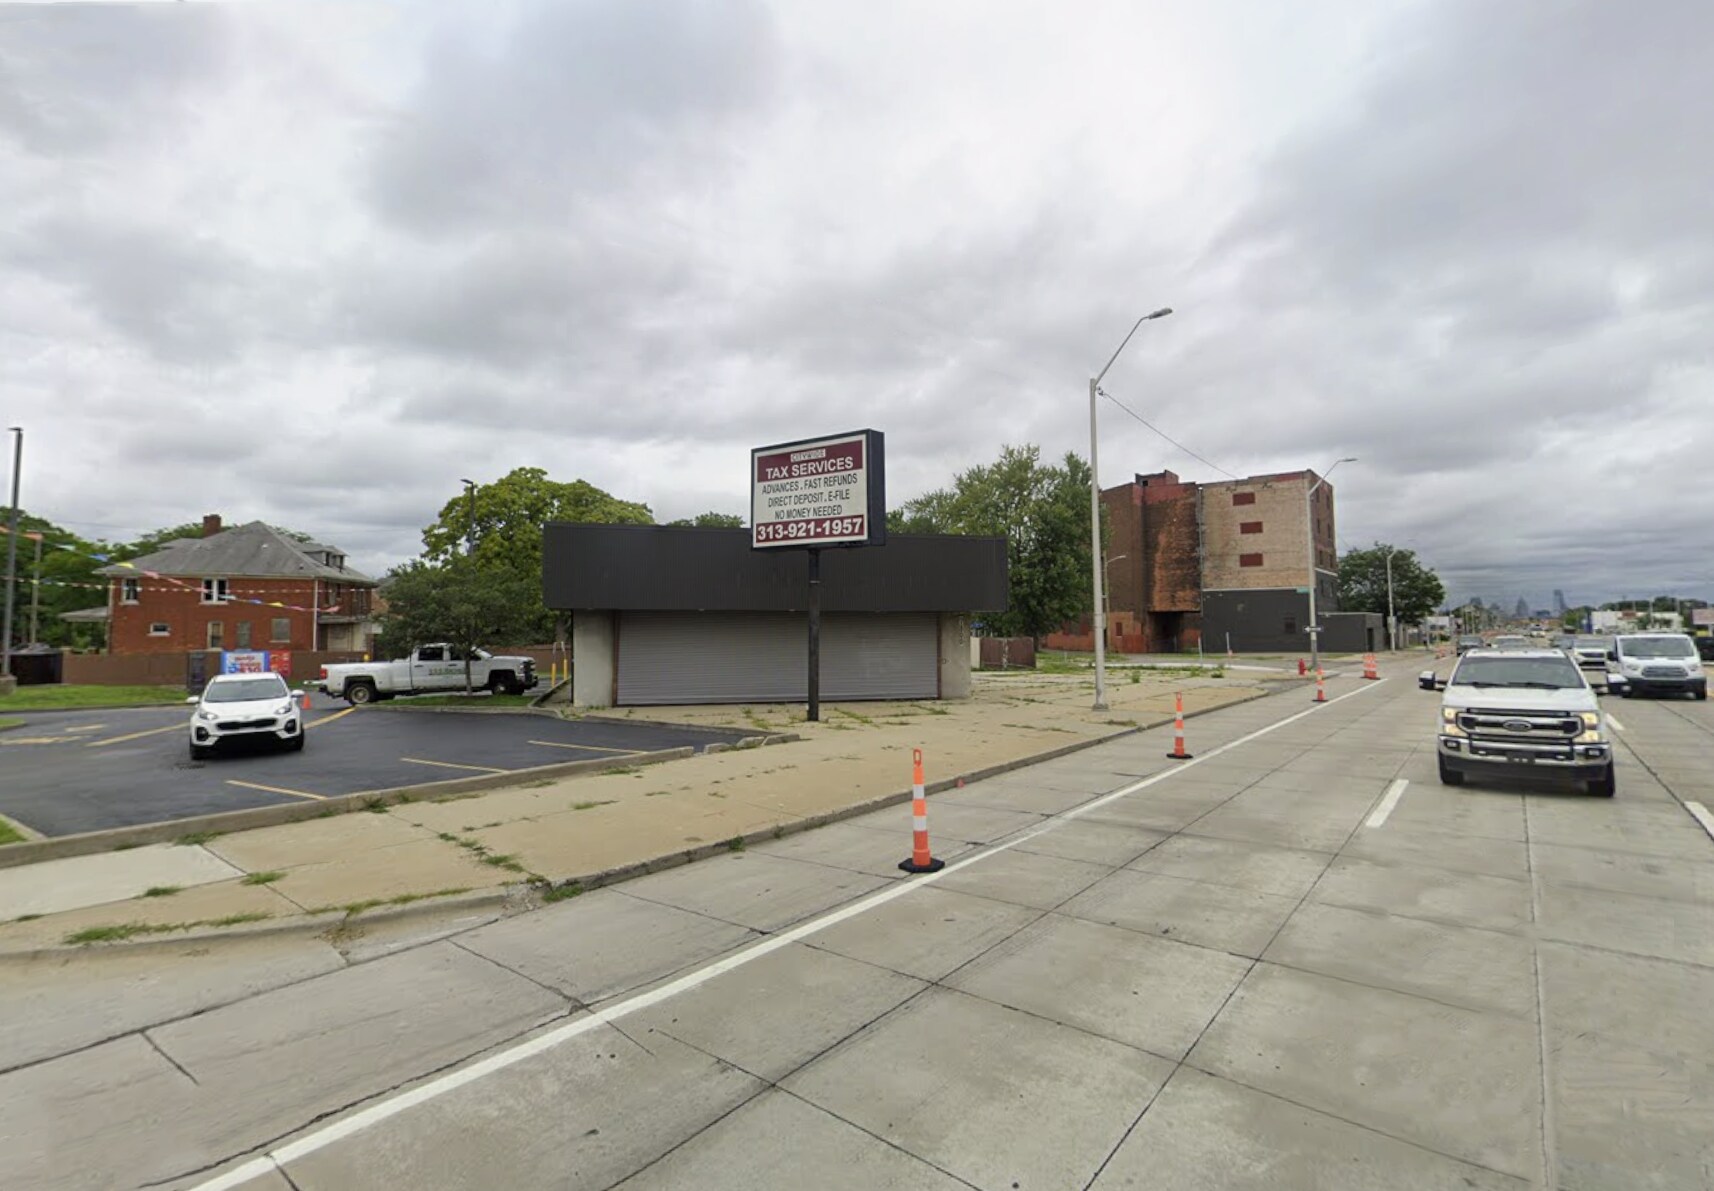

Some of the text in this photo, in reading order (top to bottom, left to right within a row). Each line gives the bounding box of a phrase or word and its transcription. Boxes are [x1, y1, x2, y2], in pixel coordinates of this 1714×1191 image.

[766, 457, 853, 479] TAX SERVICES
[762, 481, 799, 495] ADVANCES
[804, 478, 821, 489] FAST
[824, 474, 857, 486] REFUNDS
[768, 496, 792, 508] DIRECT
[794, 492, 823, 505] DEPOSIT
[828, 489, 850, 501] E-FILE
[775, 505, 842, 520] NO MONEY NEEDED
[758, 518, 862, 540] 313-921-1957
